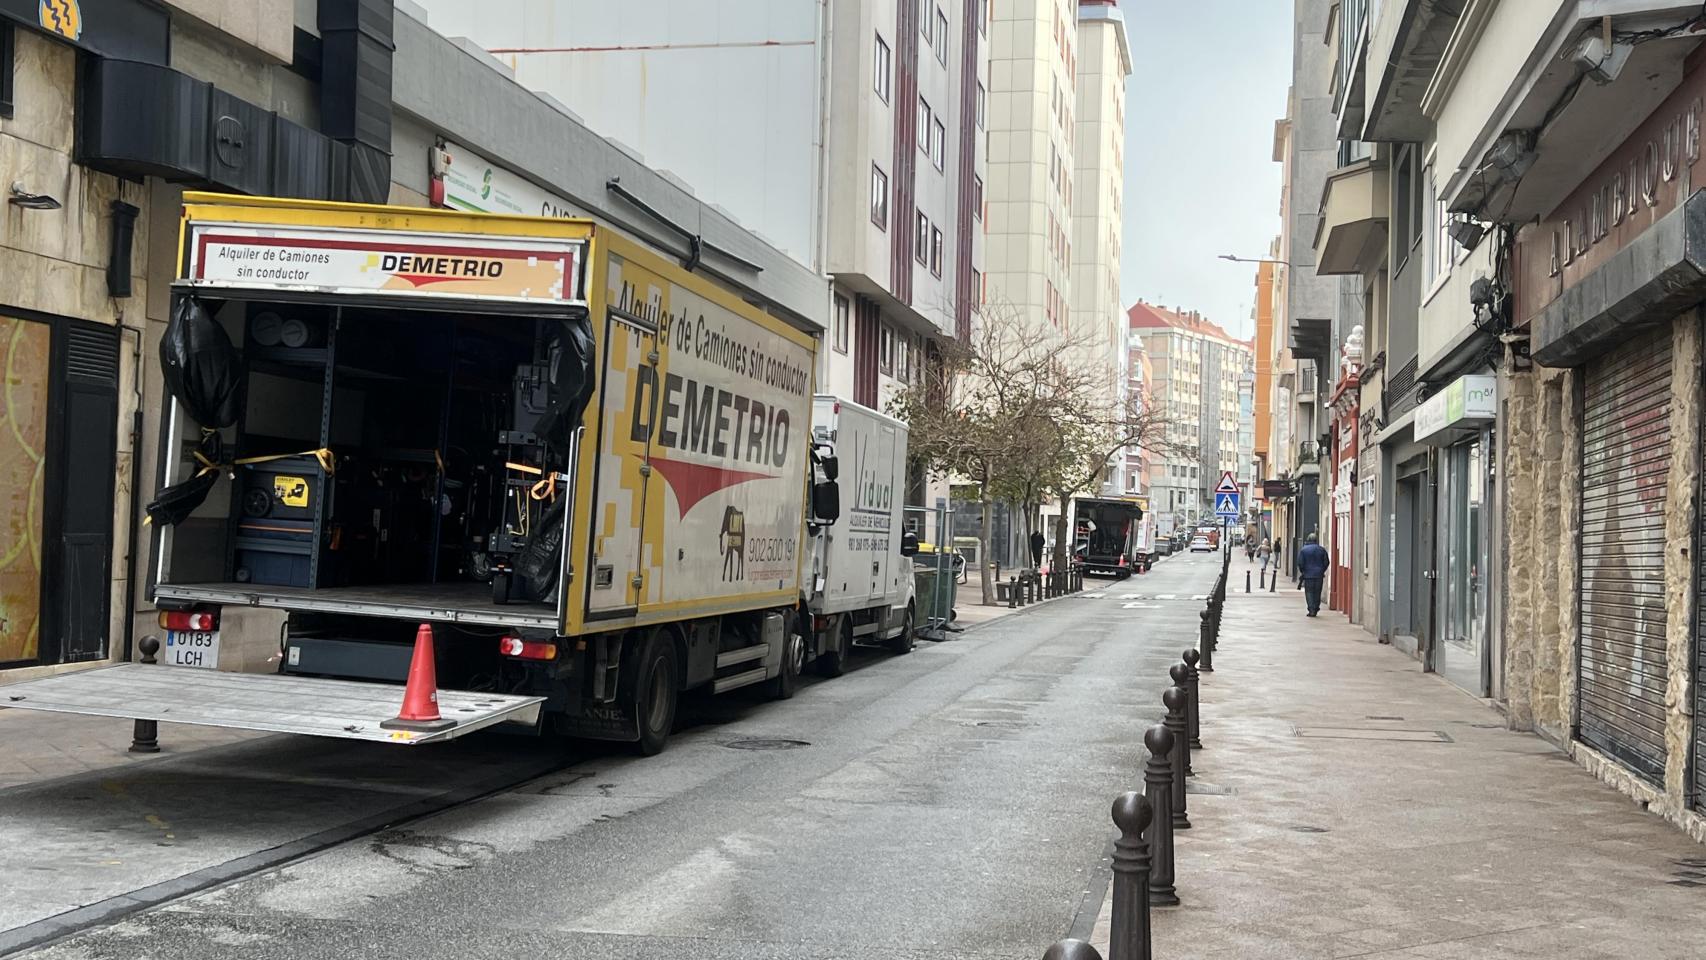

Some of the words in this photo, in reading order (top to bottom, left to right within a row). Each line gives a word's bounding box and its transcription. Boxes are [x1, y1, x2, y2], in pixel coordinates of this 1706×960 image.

[1548, 101, 1700, 278] ALAMBIQUE
[218, 246, 261, 261] Alquiler
[263, 249, 276, 261] de
[279, 249, 330, 264] Camiones
[381, 255, 503, 278] DEMETRIO
[237, 266, 253, 277] sin
[256, 267, 309, 280] conductor
[617, 280, 674, 348] Alquiler
[676, 307, 692, 354] de
[695, 314, 748, 376] Camiones
[749, 341, 764, 381] sin
[765, 357, 808, 398] conductor
[631, 363, 790, 468] DEMETRIO
[748, 537, 766, 562] 902
[767, 538, 783, 562] 500
[784, 538, 796, 561] 191
[178, 632, 212, 647] 0183
[176, 650, 203, 666] LCH
